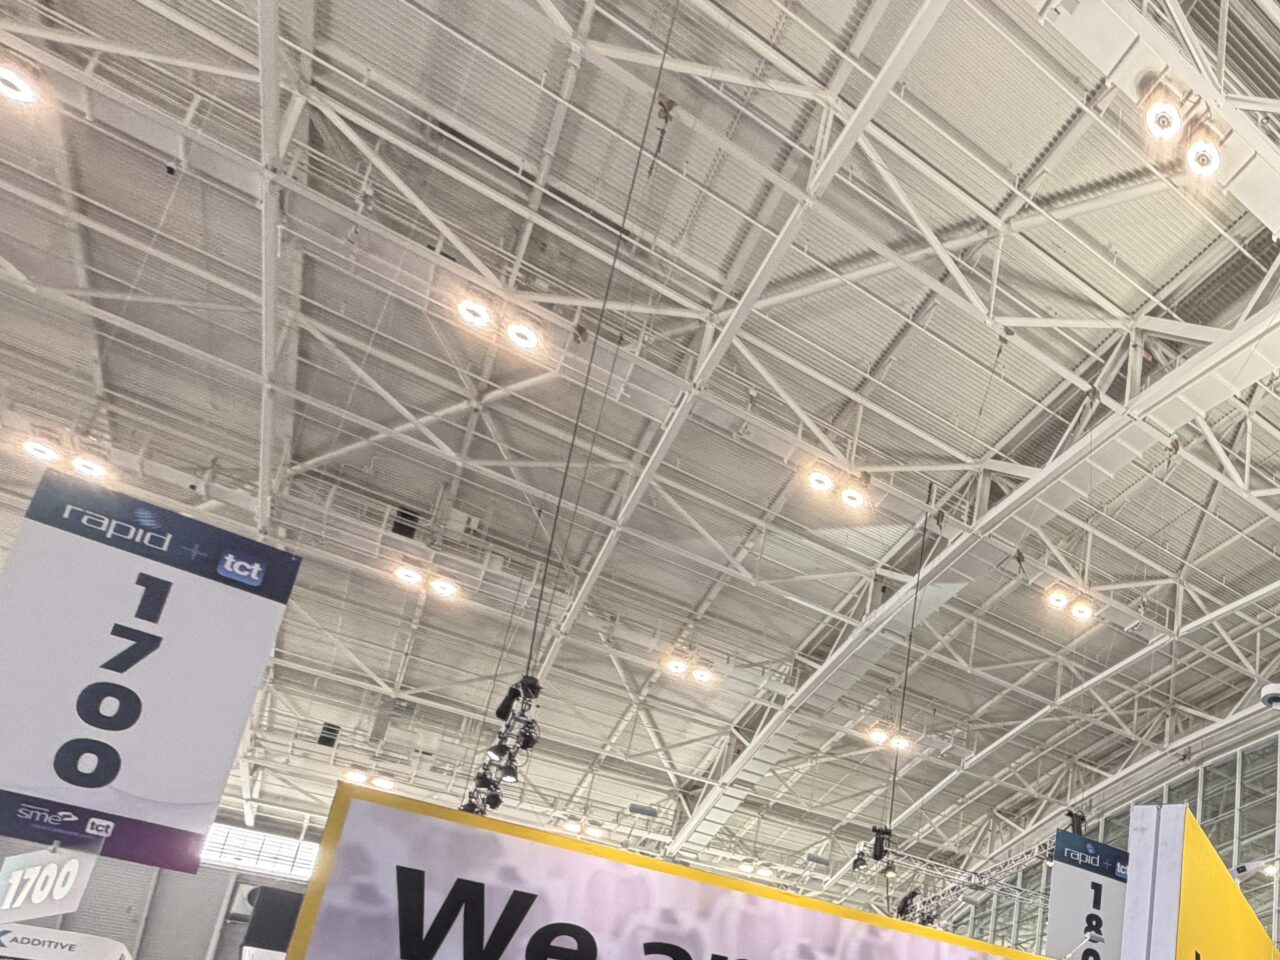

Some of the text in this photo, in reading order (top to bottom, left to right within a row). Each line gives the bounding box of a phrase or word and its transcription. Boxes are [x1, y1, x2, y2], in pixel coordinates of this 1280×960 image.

[62, 504, 173, 552] rapid
[223, 553, 264, 581] tct
[53, 572, 173, 789] 1700
[17, 807, 63, 826] sme
[89, 821, 111, 834] tct
[1064, 847, 1100, 867] rapid
[1, 859, 79, 910] 1700
[9, 936, 79, 952] ADDITIVE
